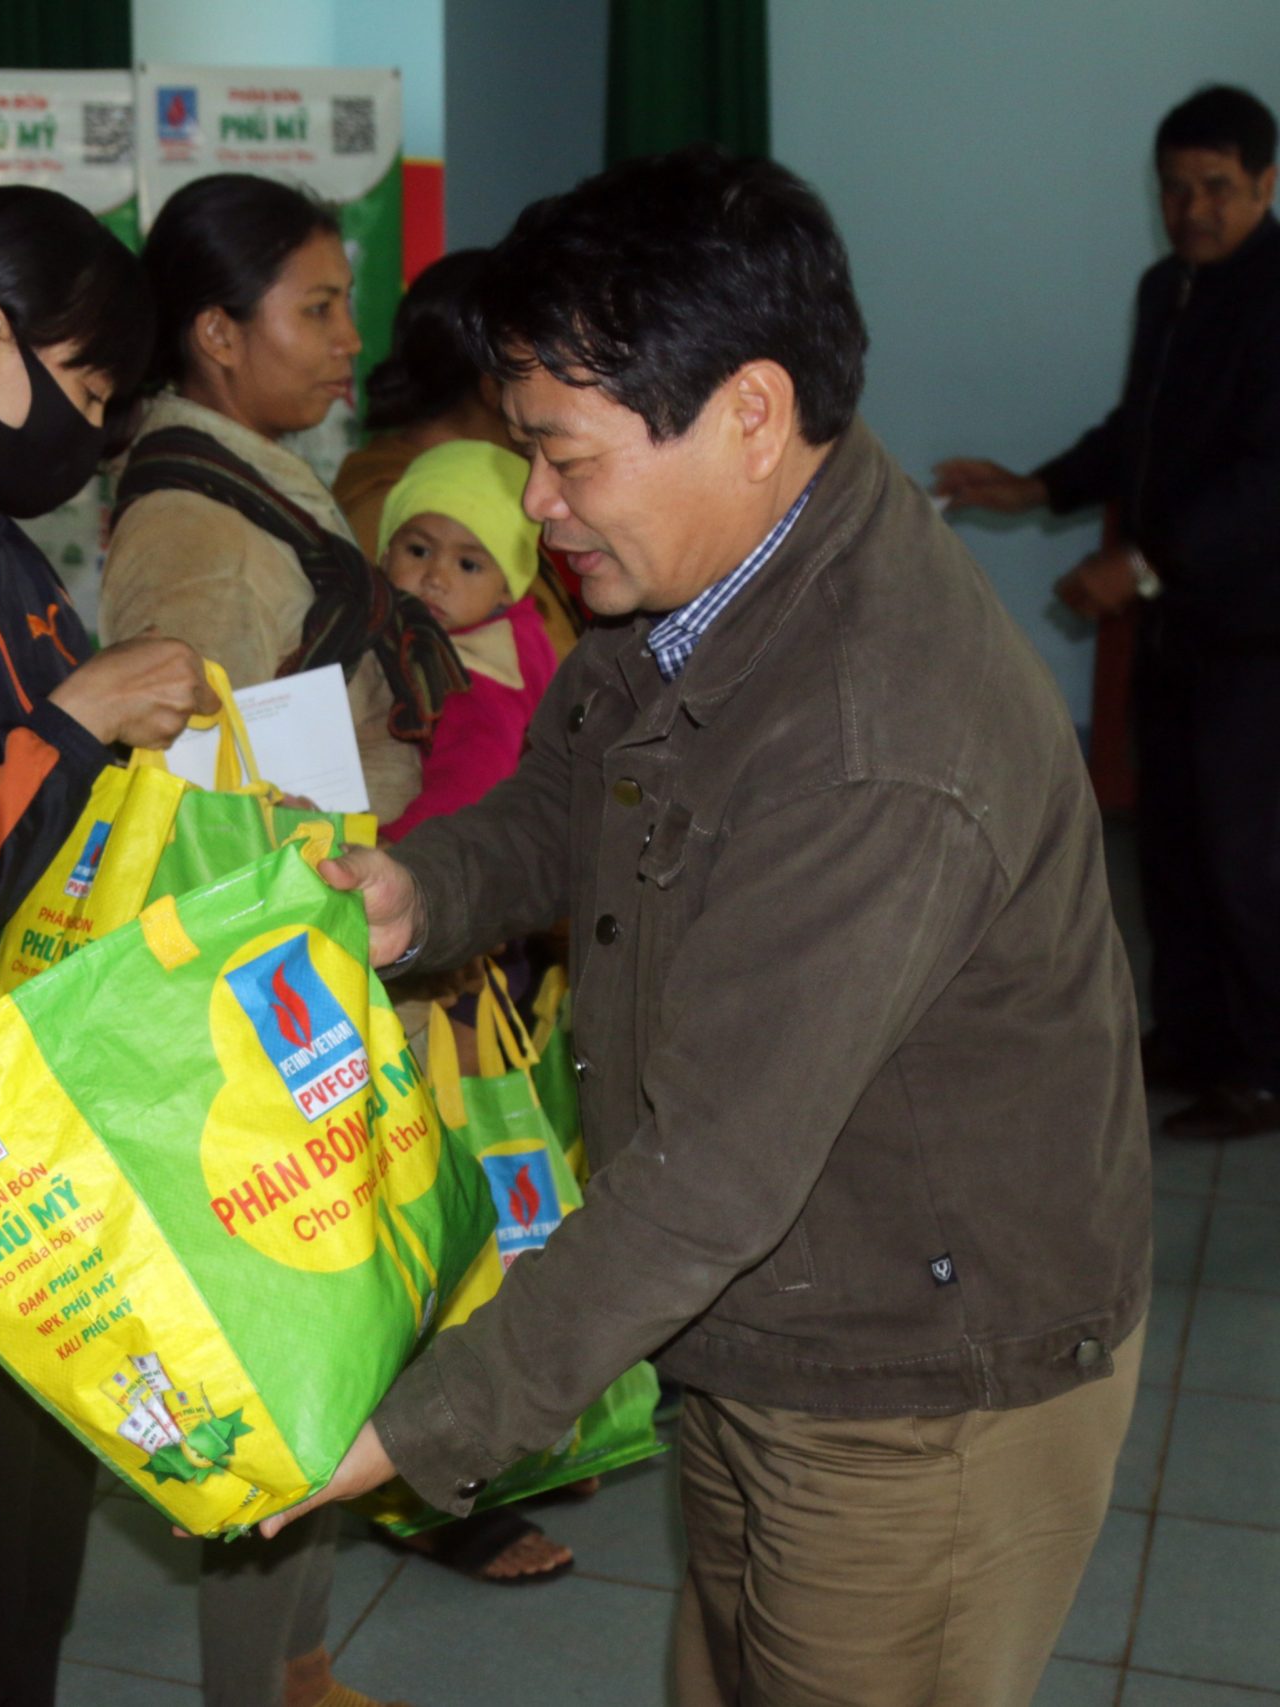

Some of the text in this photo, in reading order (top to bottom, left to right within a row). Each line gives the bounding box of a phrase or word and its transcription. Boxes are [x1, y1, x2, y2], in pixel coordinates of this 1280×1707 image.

[7, 1161, 49, 1197] BÓN
[27, 1172, 81, 1231] MỸ
[210, 1110, 370, 1237] PHÂN BÓN
[292, 1199, 351, 1241] Cho
[388, 1115, 429, 1153] thu
[16, 1246, 52, 1275] mùa
[48, 1226, 77, 1252] bội
[74, 1209, 105, 1234] thu
[48, 1263, 80, 1295] PHÚ
[80, 1246, 104, 1273] MỸ
[36, 1271, 117, 1337] NPK PHÚ MỸ
[55, 1295, 134, 1361] KALI PHÚ MỸ
